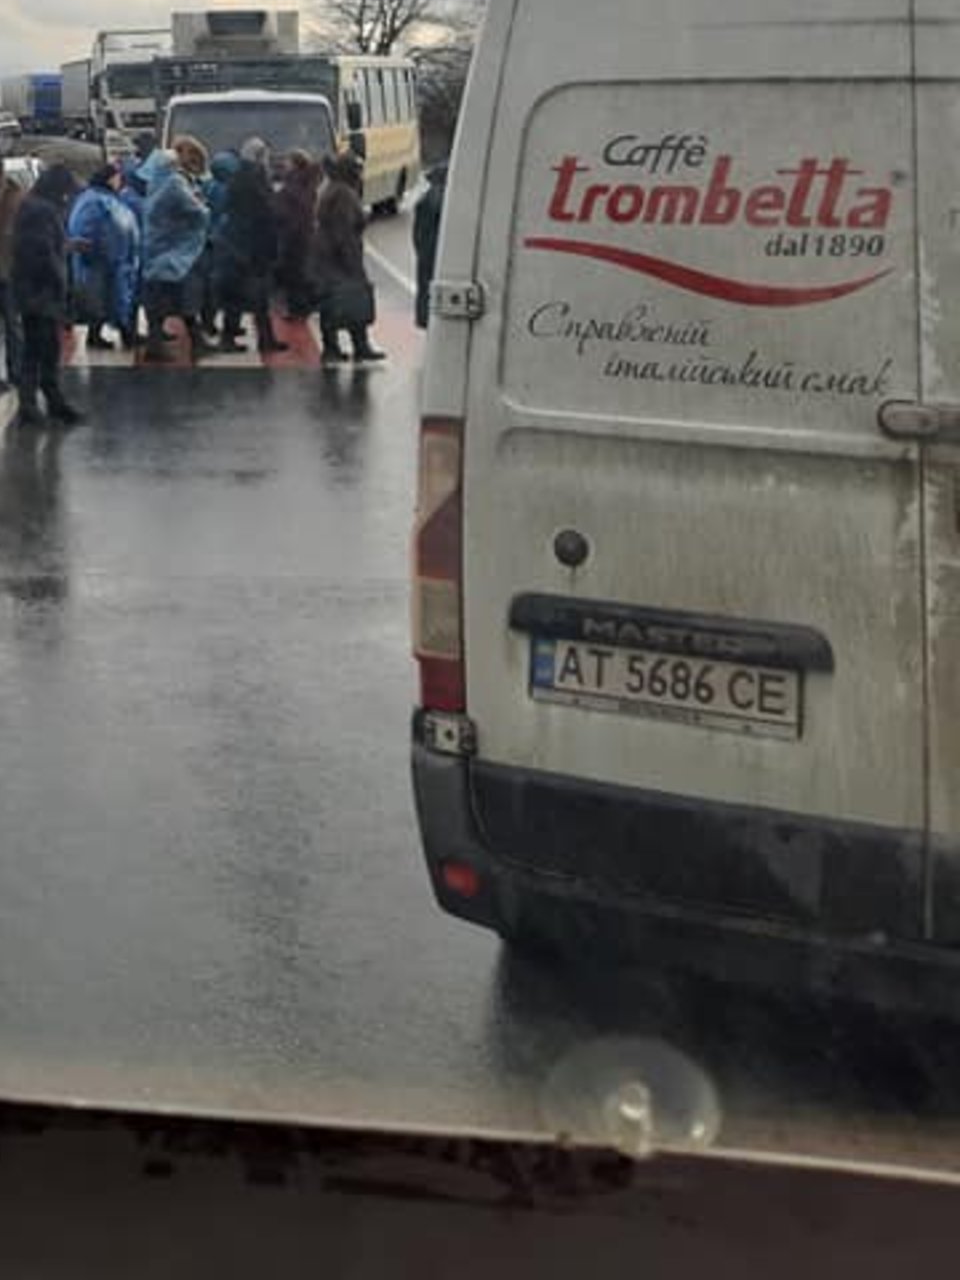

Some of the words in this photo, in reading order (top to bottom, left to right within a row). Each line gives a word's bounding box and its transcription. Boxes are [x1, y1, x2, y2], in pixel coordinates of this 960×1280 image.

[547, 154, 893, 230] trombetta
[527, 302, 712, 355] Справжній
[800, 358, 893, 397] смак
[558, 646, 614, 688] AT
[625, 656, 715, 705] 5686
[727, 671, 787, 715] CE
